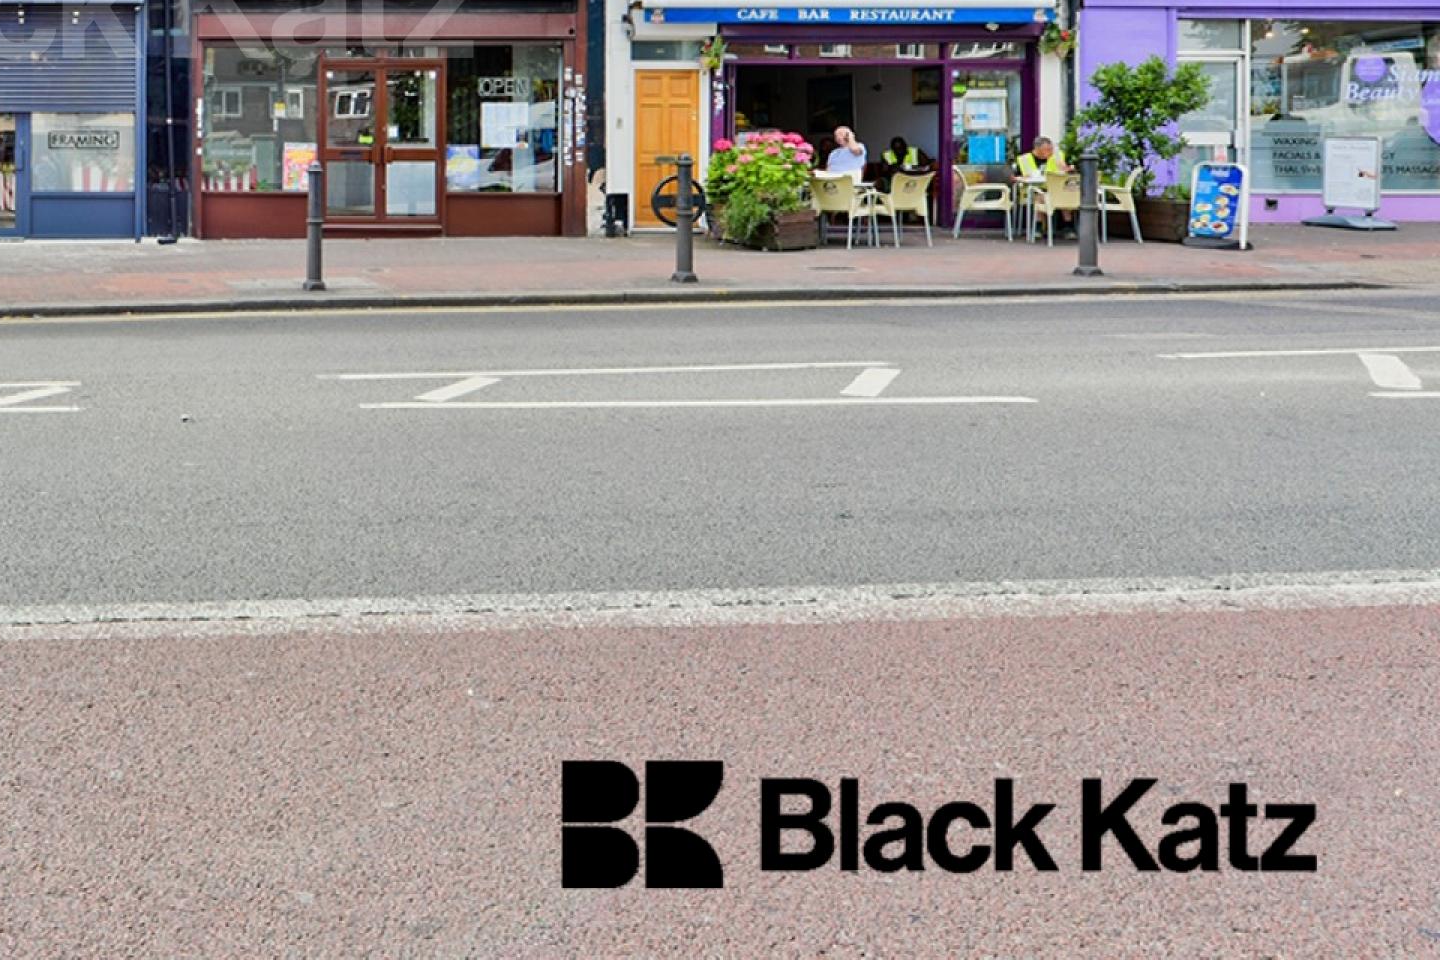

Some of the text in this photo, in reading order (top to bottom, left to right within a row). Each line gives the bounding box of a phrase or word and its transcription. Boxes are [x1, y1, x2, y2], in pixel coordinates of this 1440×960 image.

[737, 9, 955, 21] CAFE BAR RESTAURANT
[480, 78, 528, 95] OPEN
[51, 133, 116, 147] FRAMING
